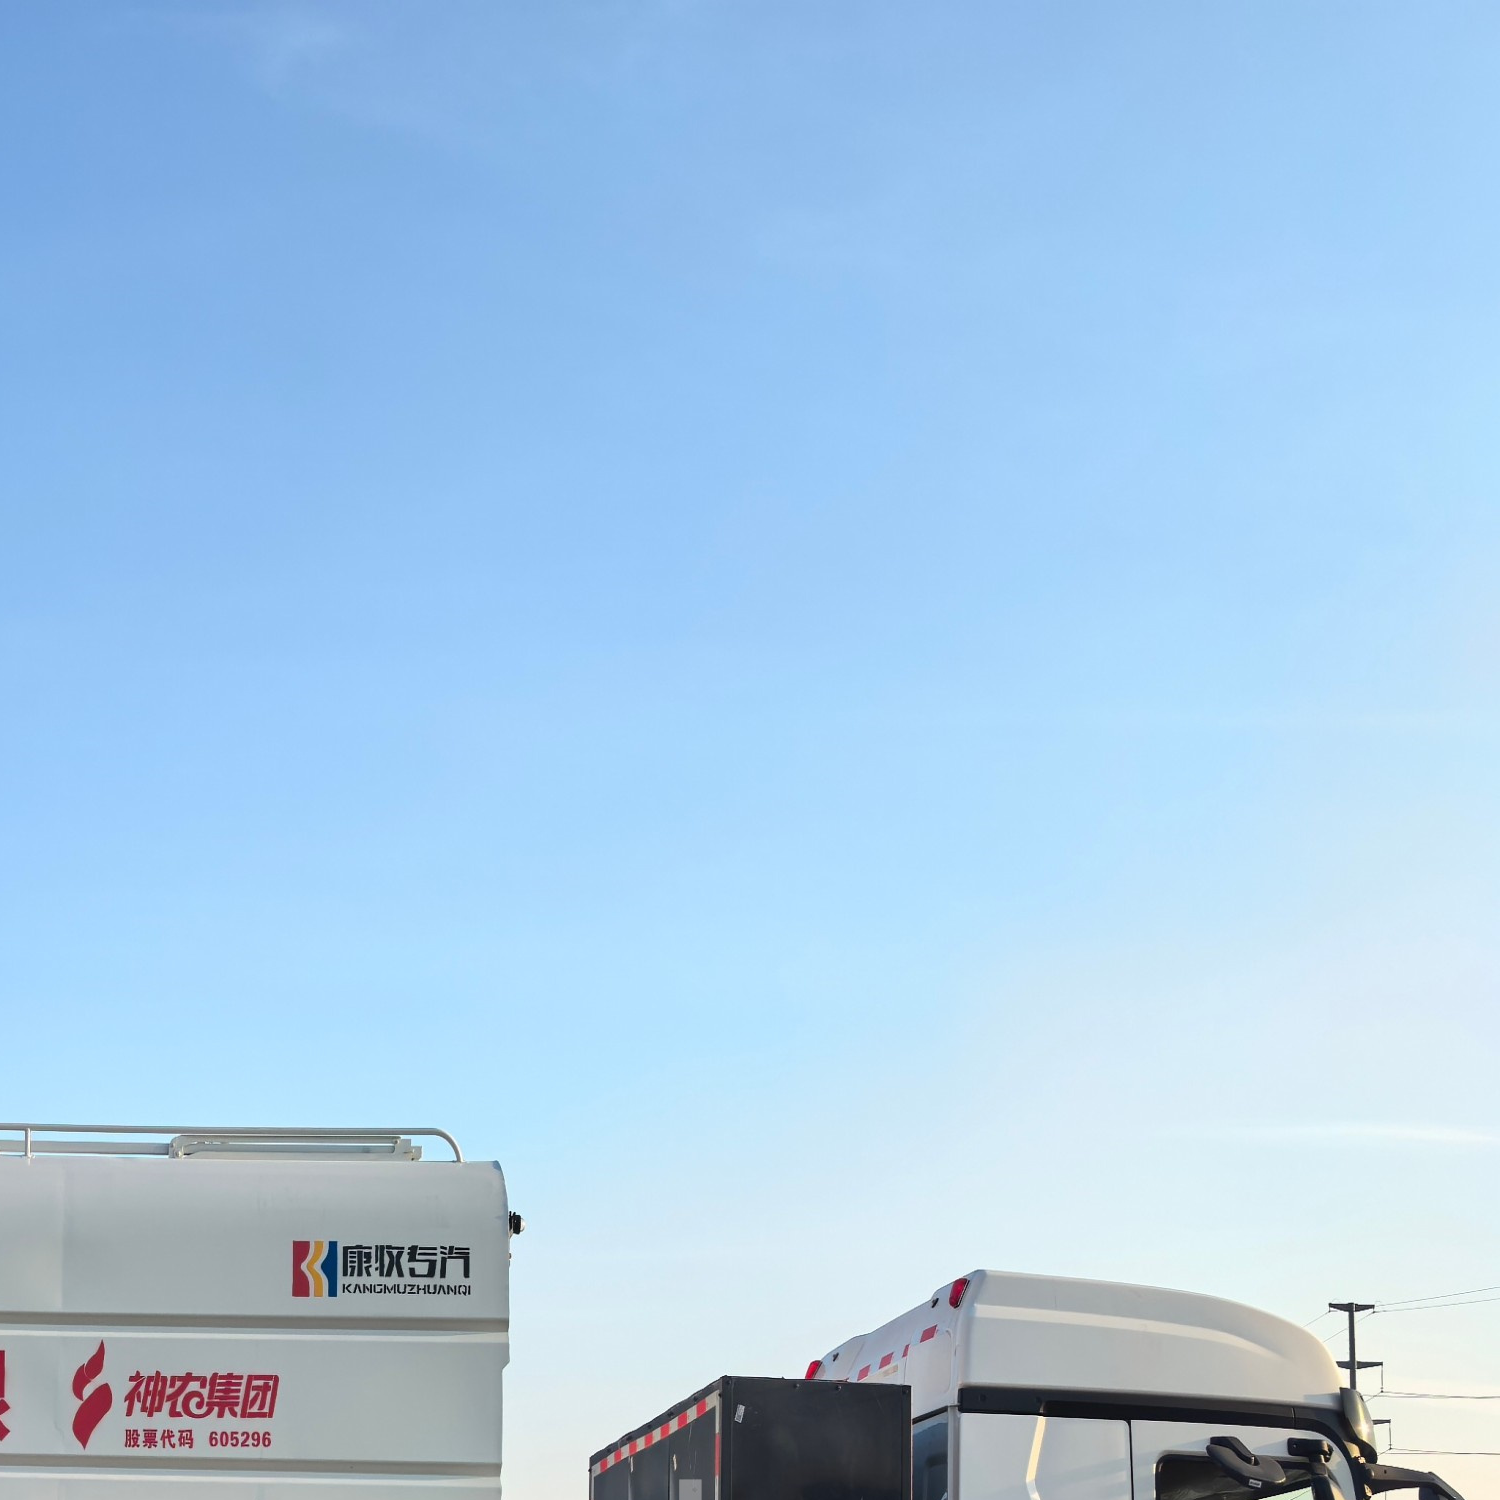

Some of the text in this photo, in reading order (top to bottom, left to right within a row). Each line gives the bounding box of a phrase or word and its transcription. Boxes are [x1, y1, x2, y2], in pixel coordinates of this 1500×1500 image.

[342, 1244, 470, 1279] 康牧专汽
[342, 1283, 472, 1297] KANGMUZHUANQI
[123, 1370, 280, 1418] 神农集团
[124, 1428, 272, 1449] 股票代码 605296
